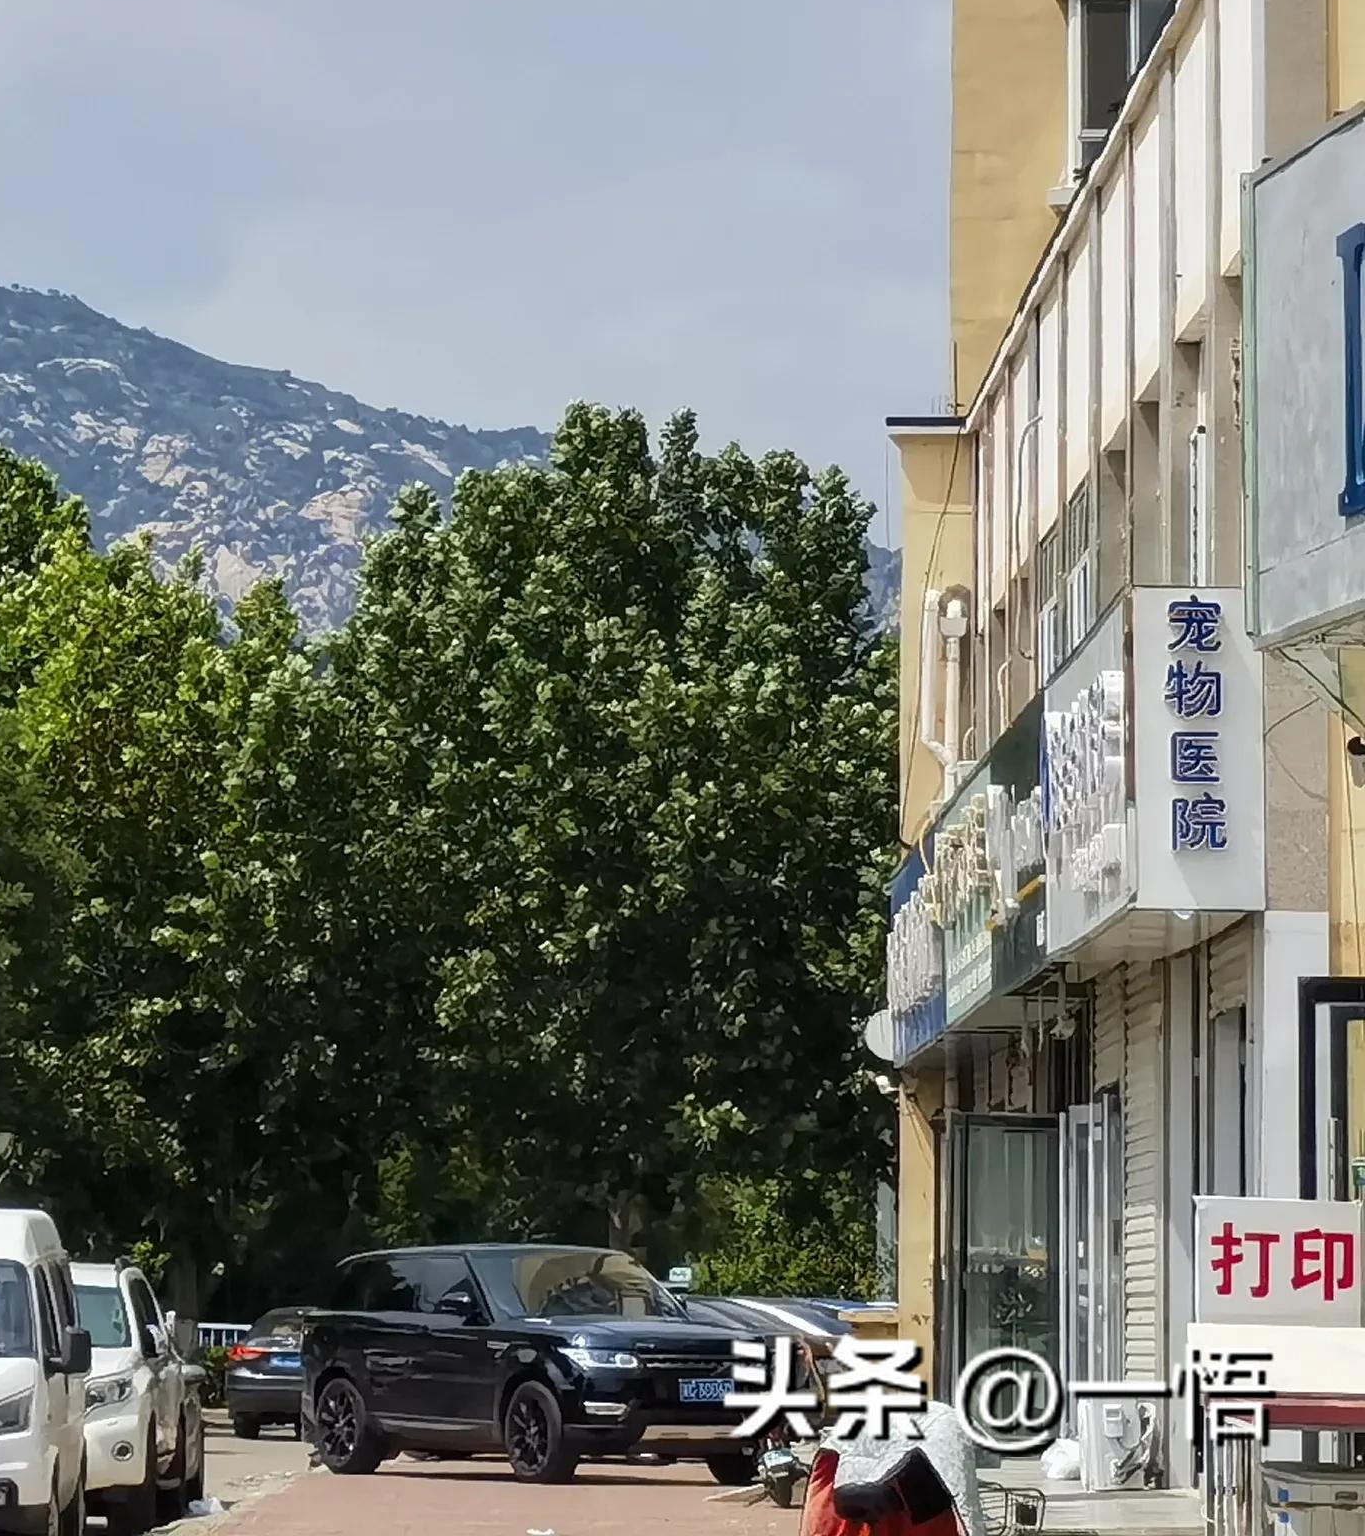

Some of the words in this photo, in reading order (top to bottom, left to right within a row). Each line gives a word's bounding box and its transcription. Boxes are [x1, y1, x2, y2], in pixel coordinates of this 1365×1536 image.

[1164, 594, 1228, 853] 宠物医院
[1209, 1221, 1355, 1302] 打印
